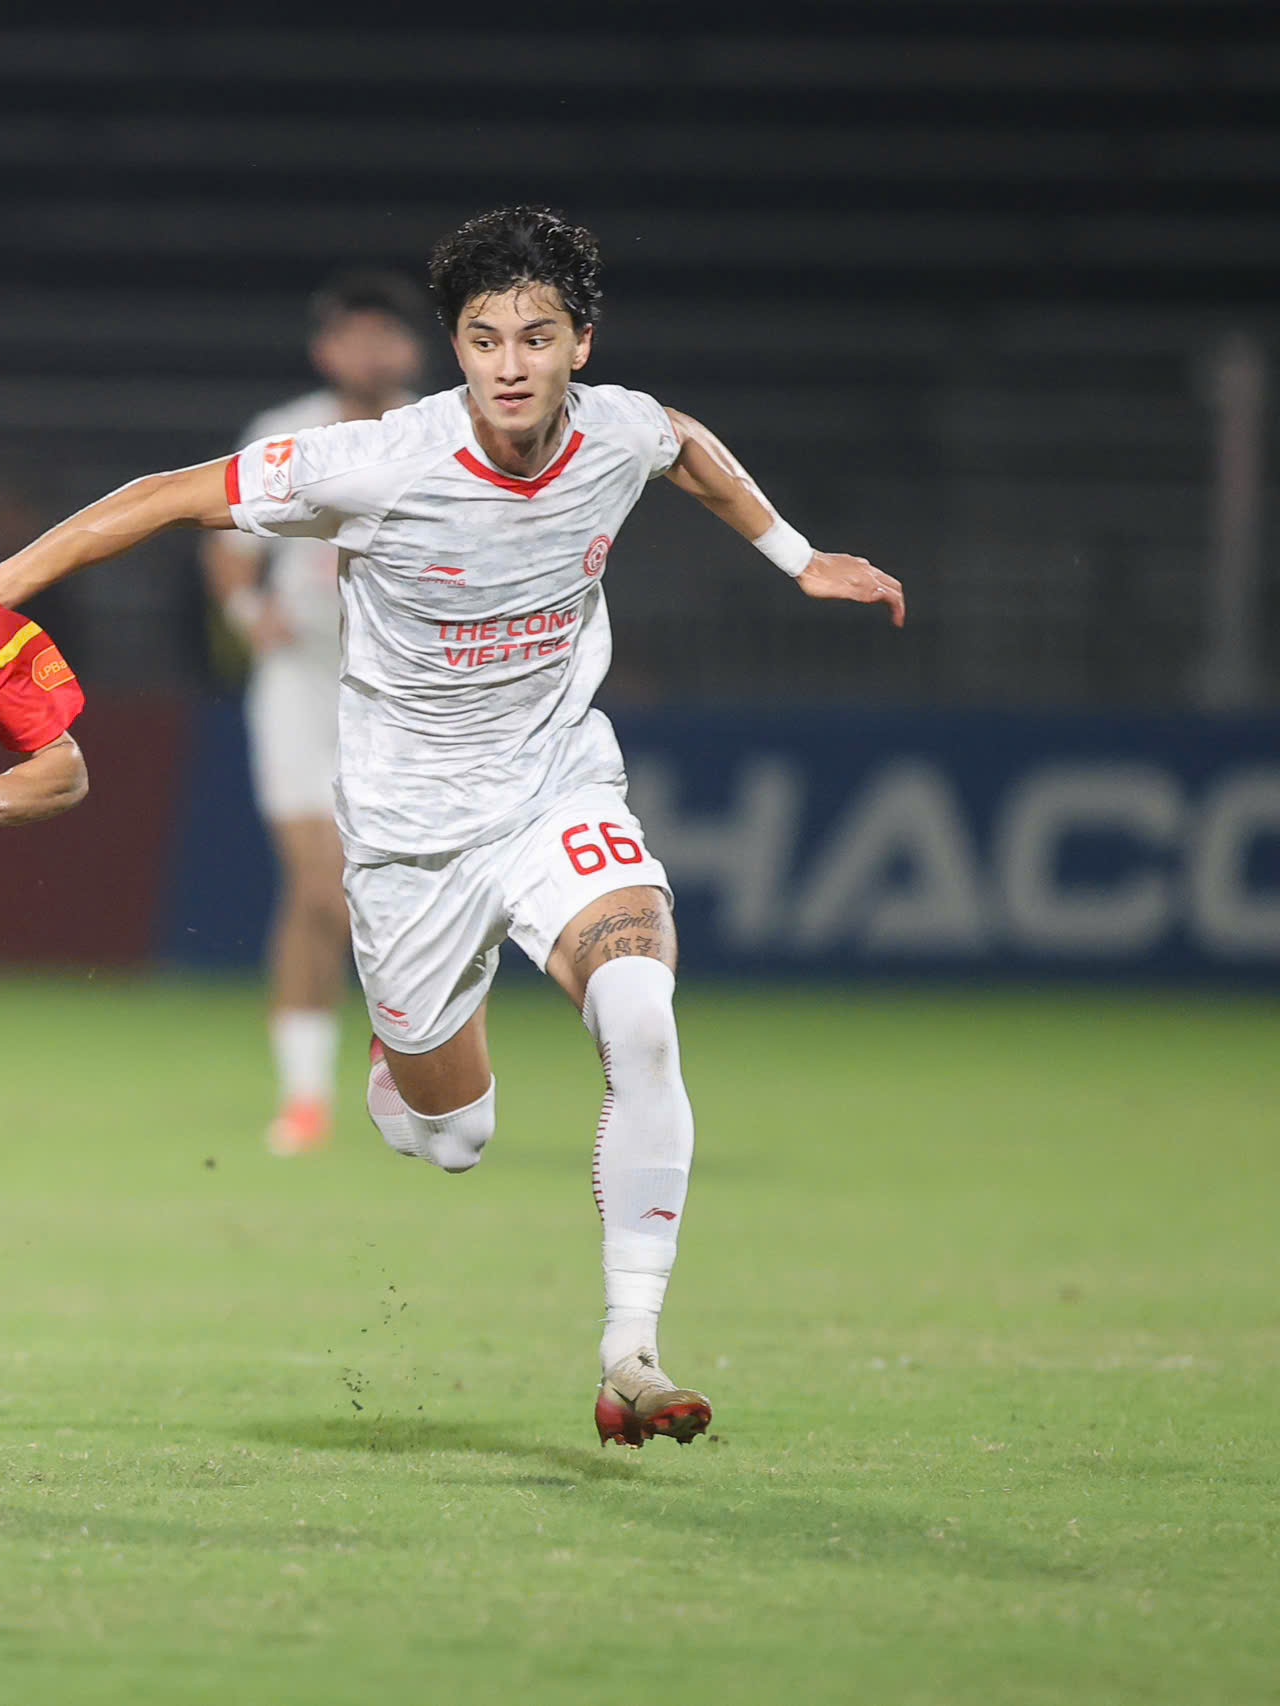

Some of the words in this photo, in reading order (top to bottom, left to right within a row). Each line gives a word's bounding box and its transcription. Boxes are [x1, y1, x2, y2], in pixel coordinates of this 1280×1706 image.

[444, 635, 571, 668] VIETTEL
[38, 660, 69, 681] LPBa
[561, 822, 643, 876] 66
